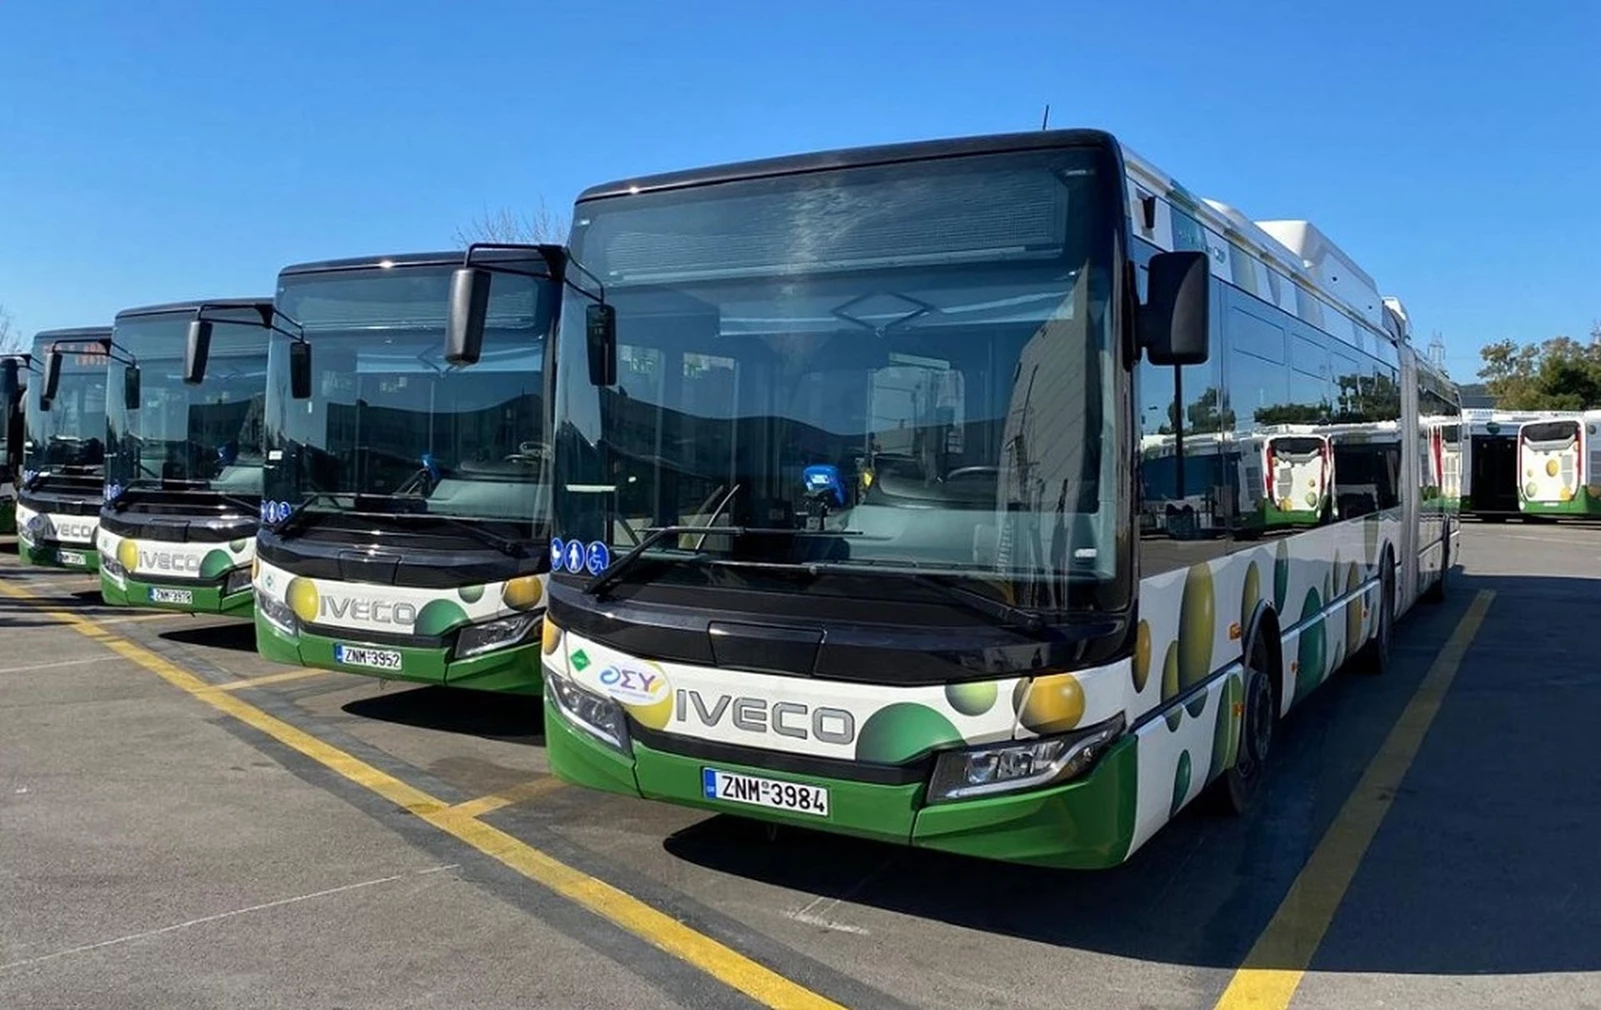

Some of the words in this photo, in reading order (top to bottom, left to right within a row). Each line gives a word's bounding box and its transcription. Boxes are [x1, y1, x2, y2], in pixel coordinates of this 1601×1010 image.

[139, 550, 200, 571] IVECO
[320, 595, 417, 625] IVECO
[676, 689, 855, 745] IVECO
